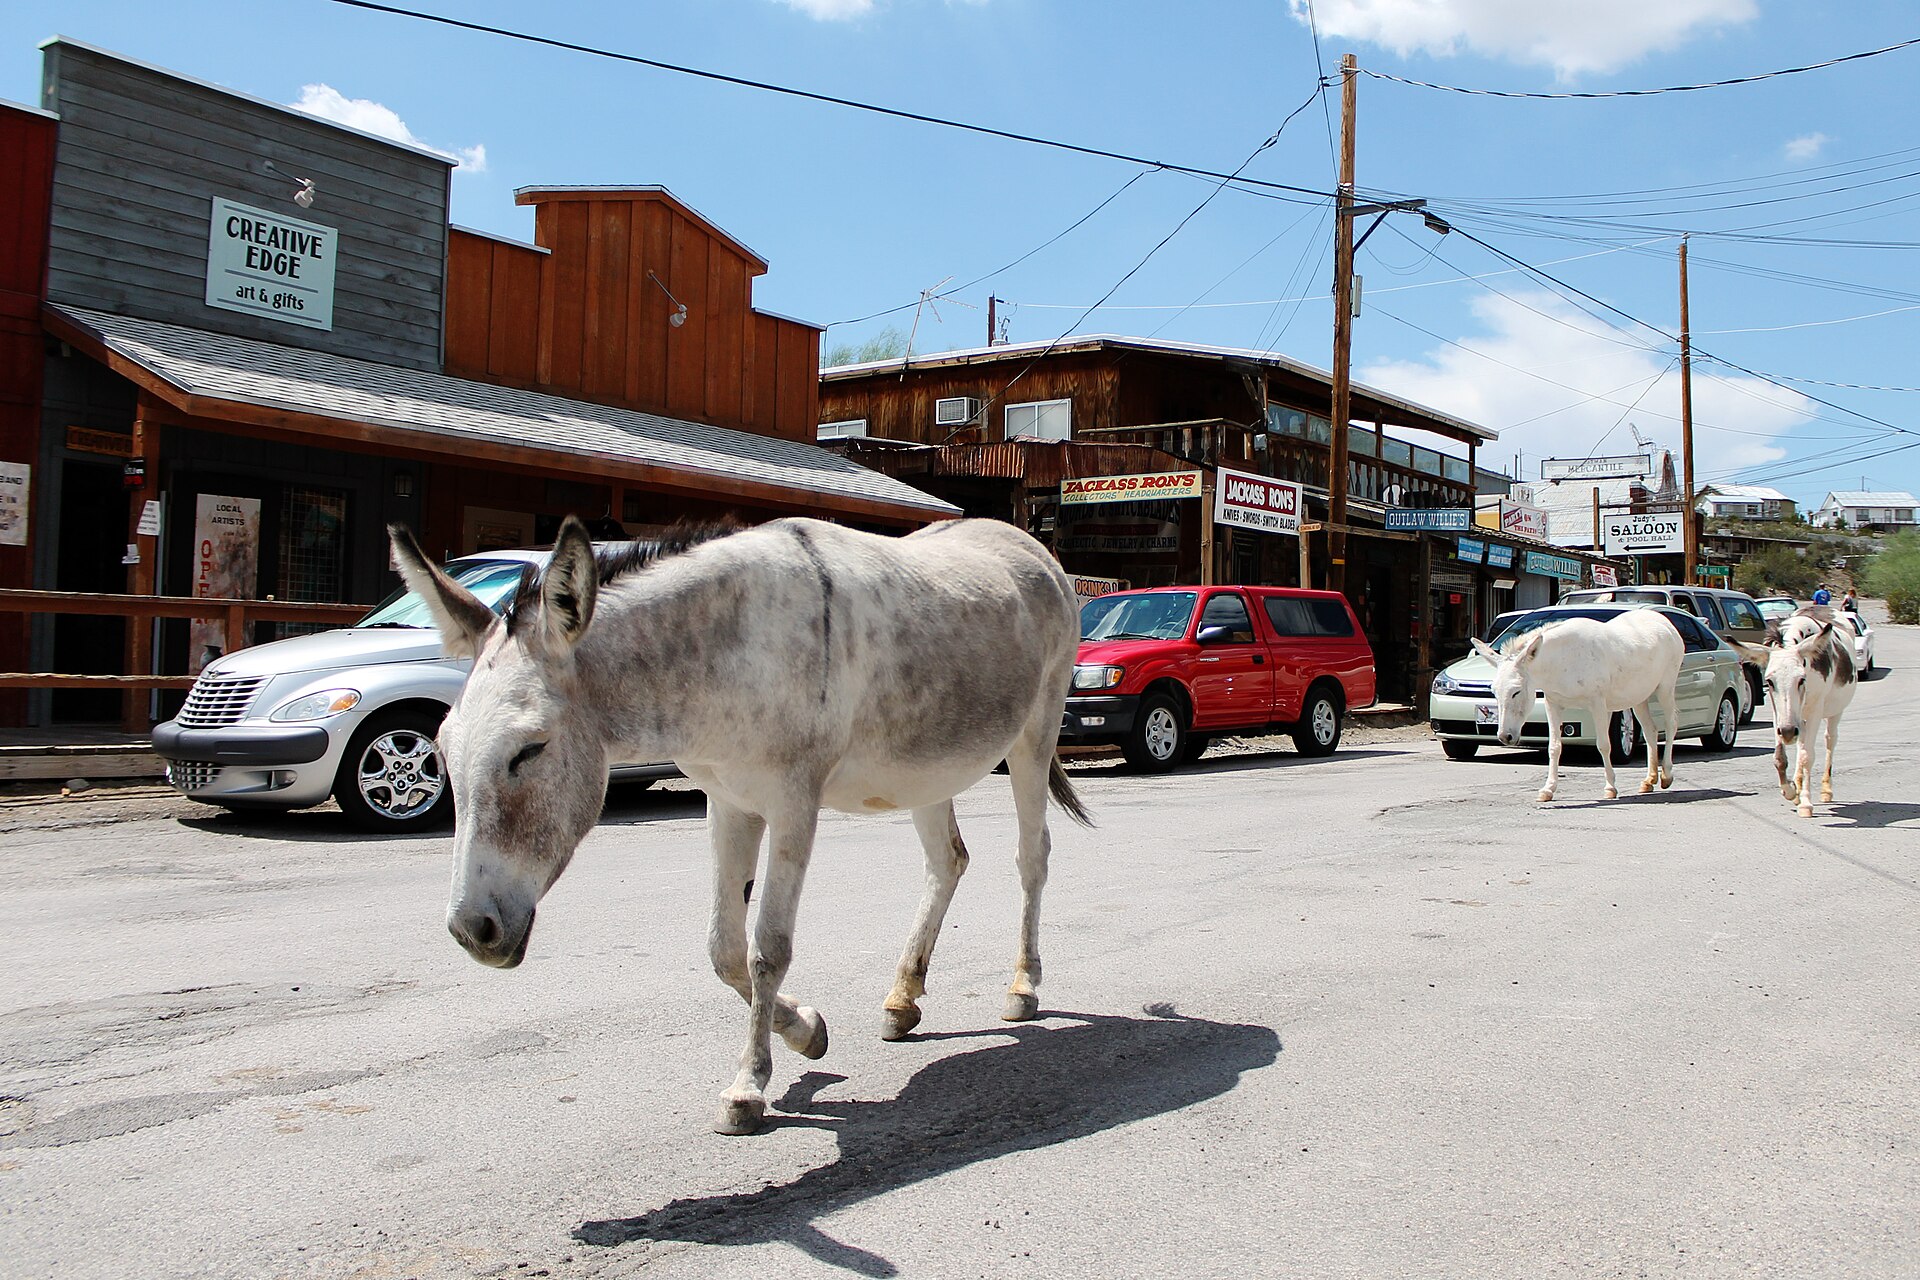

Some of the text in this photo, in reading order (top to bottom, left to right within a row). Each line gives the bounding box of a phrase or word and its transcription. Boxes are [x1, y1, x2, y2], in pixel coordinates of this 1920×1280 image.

[226, 216, 322, 259] CREATIVE
[246, 245, 301, 279] EDGE
[236, 285, 304, 310] art & gifts
[1567, 463, 1624, 473] MERCANTILE
[1063, 474, 1196, 494] JACKASS RON'S
[1064, 487, 1192, 502] COLLECTORS' HEADQUARTERS
[1227, 479, 1294, 511] JACKASS RON'S
[216, 504, 242, 513] LOCAL
[211, 516, 245, 526] ARTISTS
[1222, 508, 1240, 521] KNIVES
[1243, 511, 1260, 525] SWORDS
[1262, 514, 1279, 528] SWITCH
[1280, 517, 1296, 531] BLADES
[1389, 513, 1465, 526] OUTLAW WILLIE'S
[1633, 515, 1655, 523] Judy's
[1611, 522, 1678, 536] SALOON
[1102, 537, 1138, 549] JEWELRY
[1146, 536, 1177, 548] CHARMS
[196, 539, 212, 624] OPE
[1075, 578, 1110, 597] DRINKS
